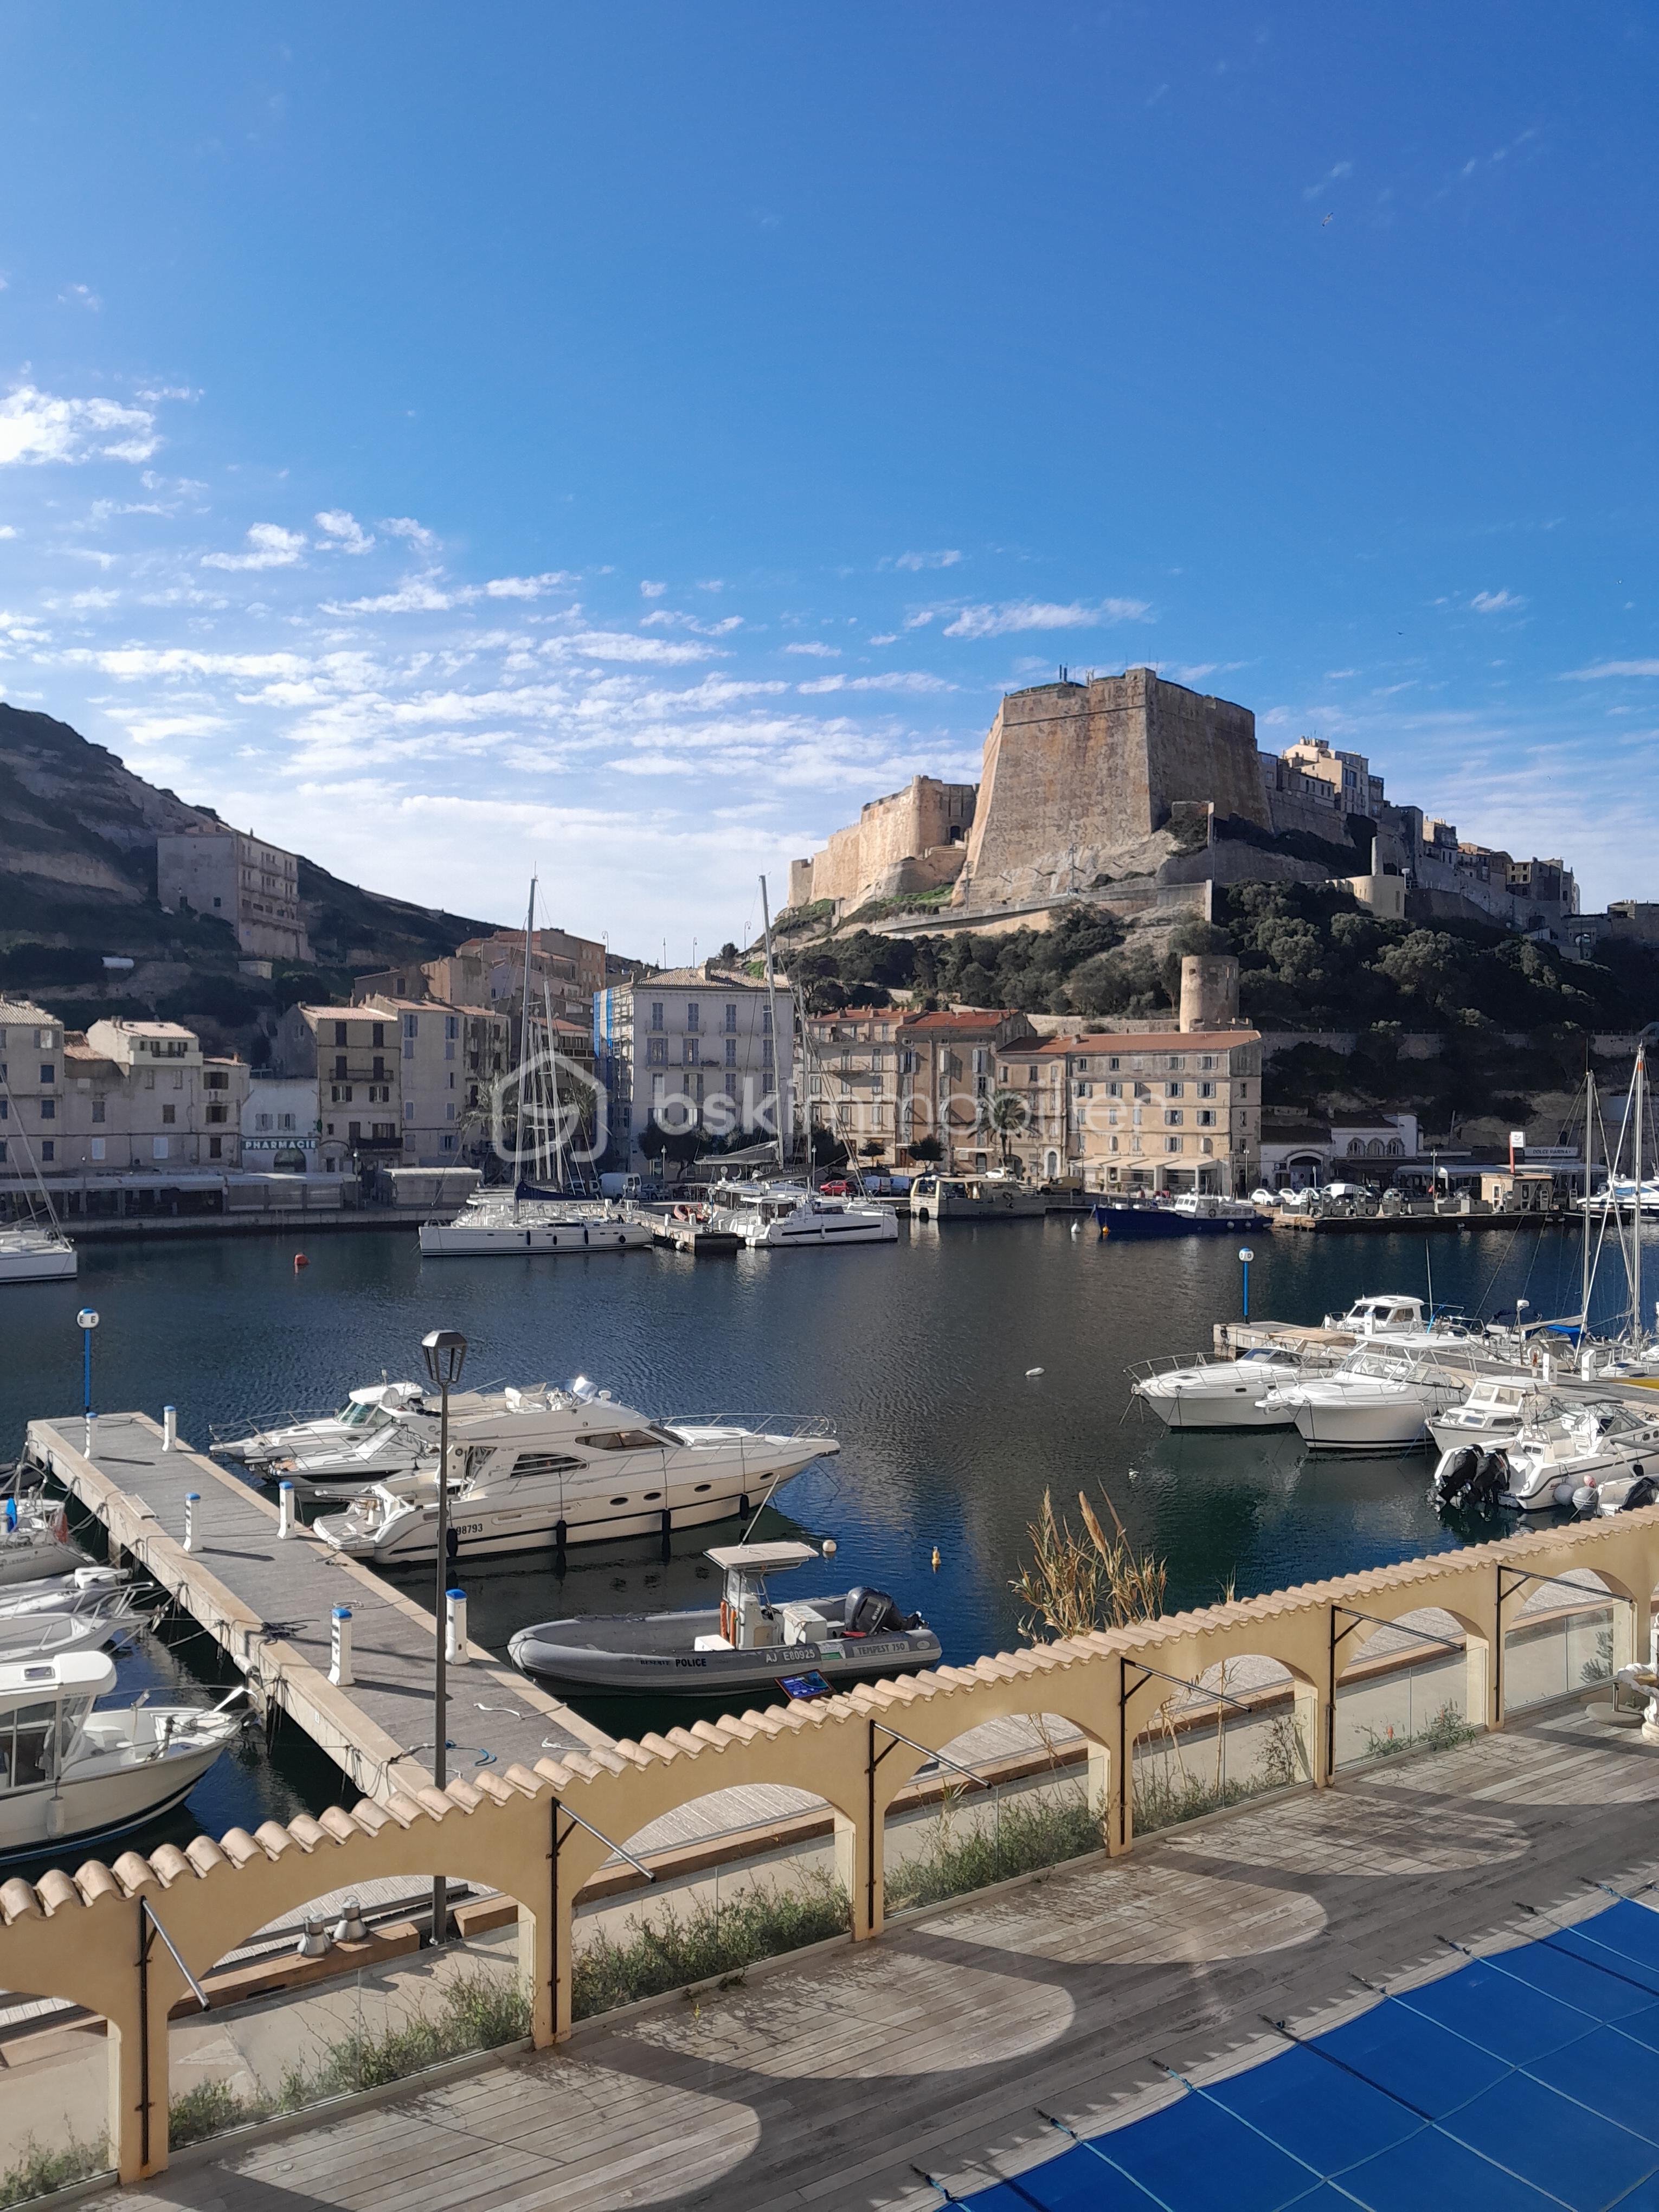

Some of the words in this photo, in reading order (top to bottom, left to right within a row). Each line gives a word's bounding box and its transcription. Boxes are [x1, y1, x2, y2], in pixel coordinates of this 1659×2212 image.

[245, 1140, 316, 1149] PHARMACIE
[91, 1315, 96, 1323] E
[766, 1652, 777, 1663] AJ
[675, 1658, 707, 1667] POLICE
